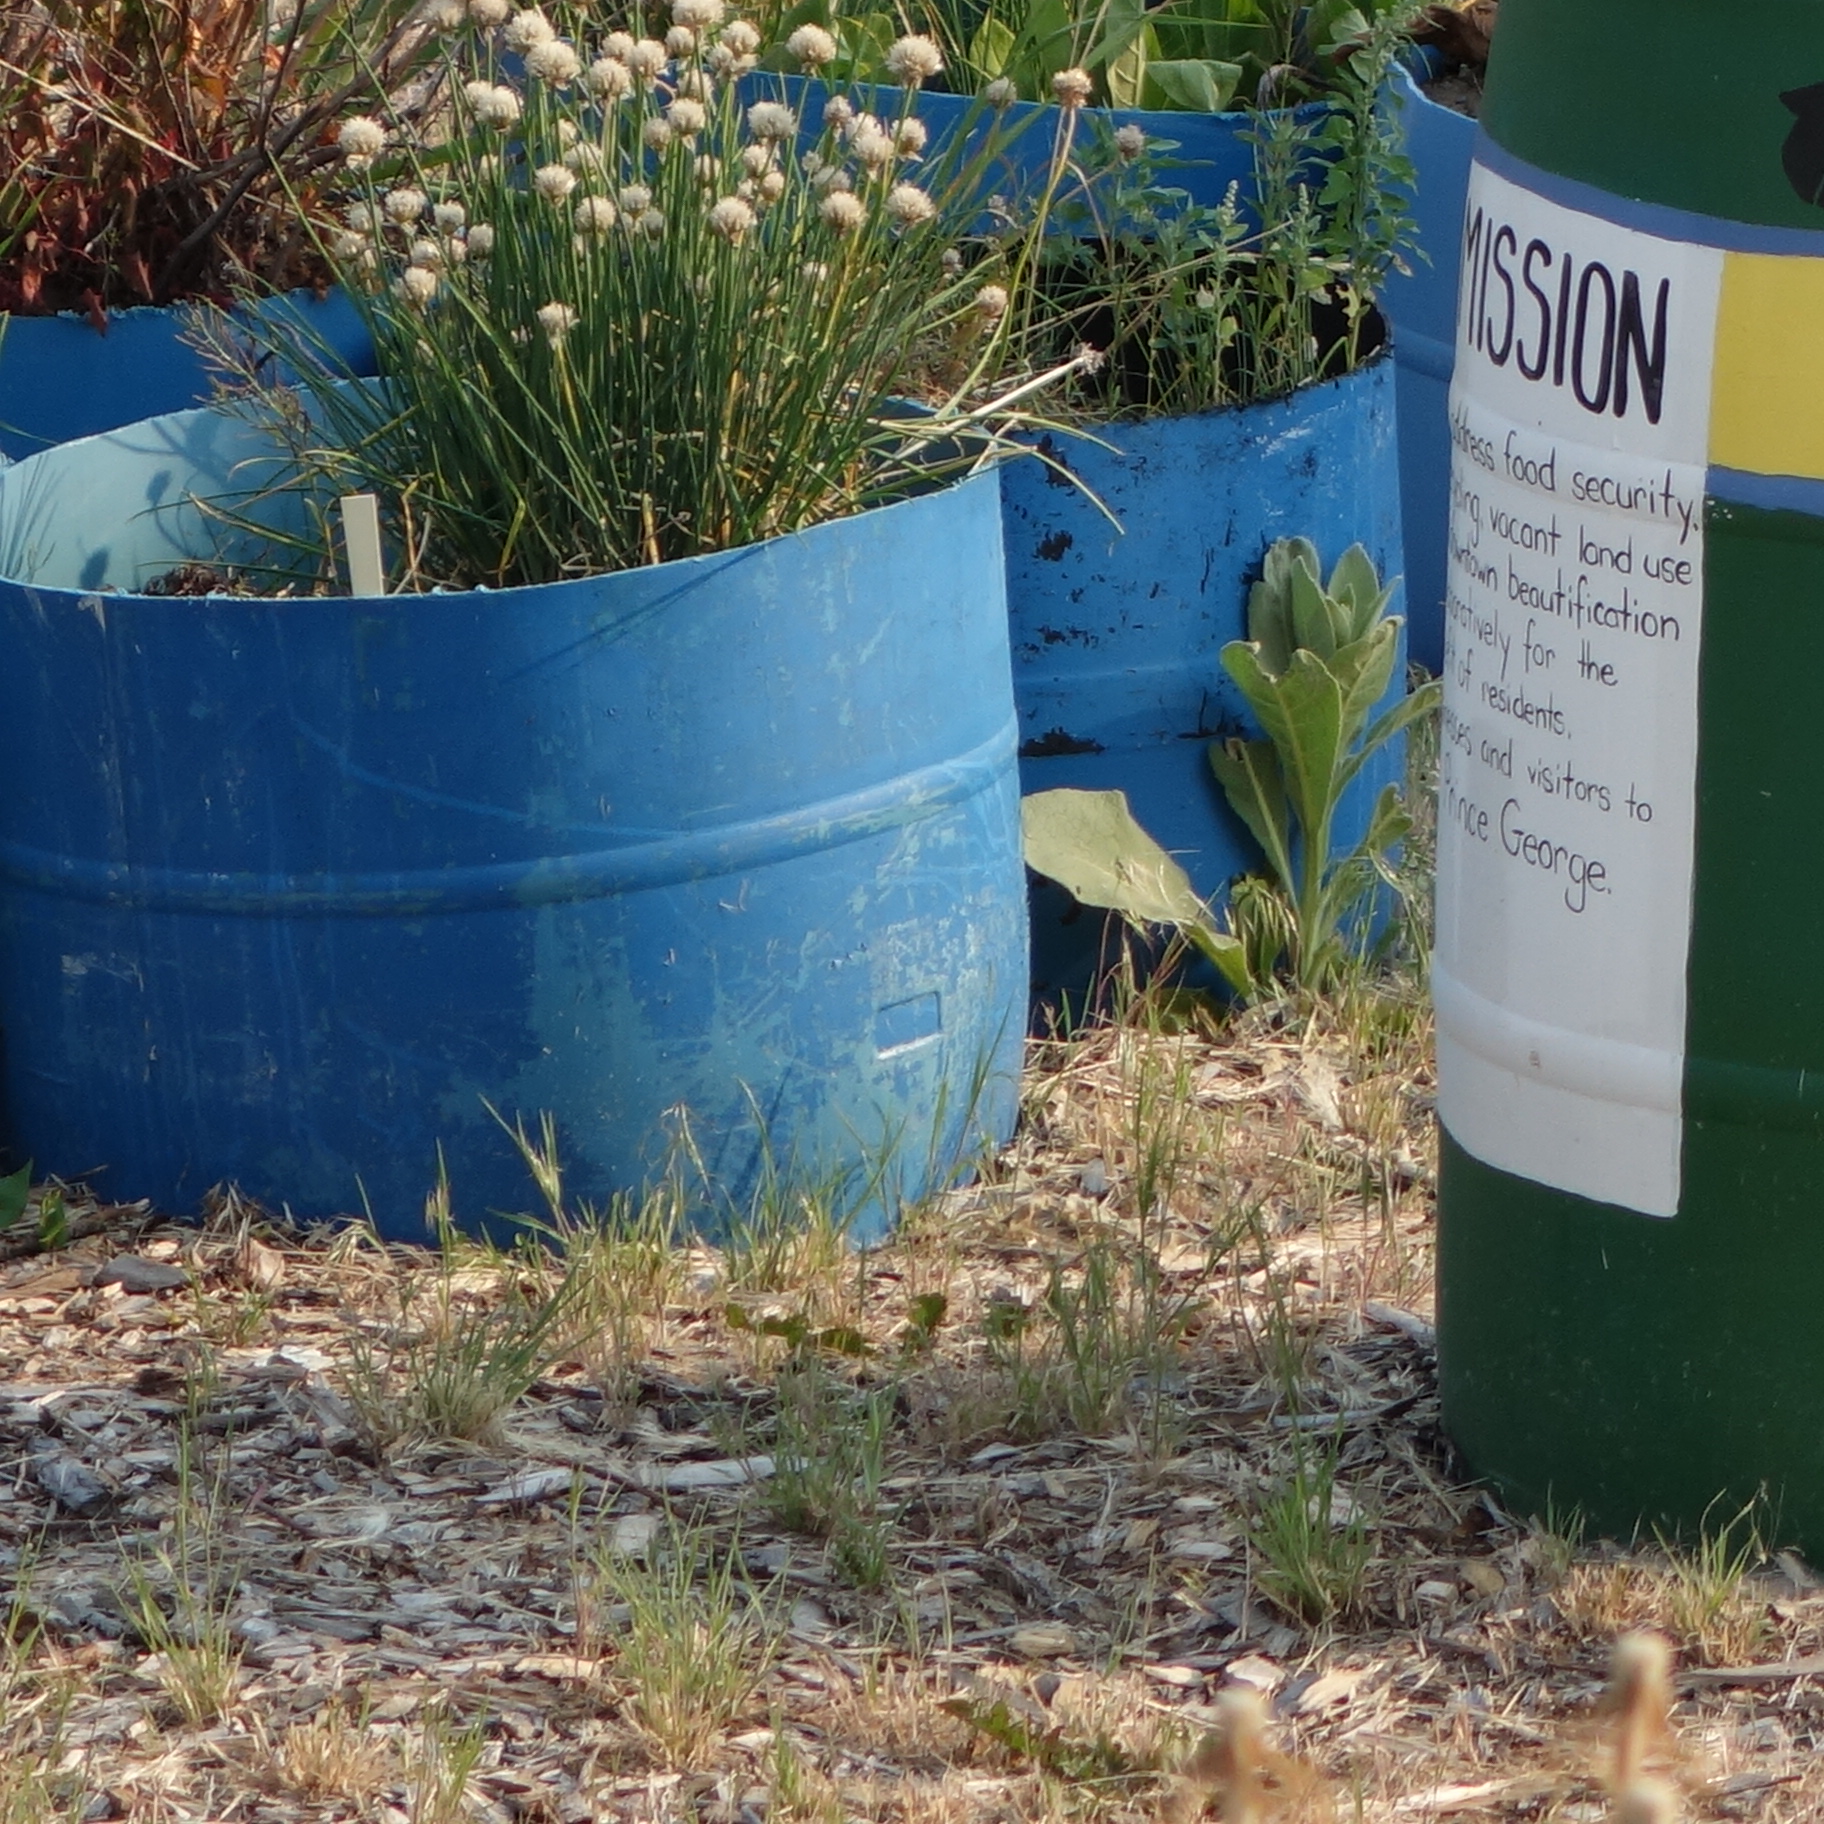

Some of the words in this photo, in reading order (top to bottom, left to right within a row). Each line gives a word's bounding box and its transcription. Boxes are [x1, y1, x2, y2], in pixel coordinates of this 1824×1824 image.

[1464, 196, 1670, 425] MISSION
[1504, 430, 1556, 492] food
[1489, 506, 1562, 557] vacant
[1579, 524, 1632, 575] land
[1643, 554, 1693, 586] use
[1508, 552, 1680, 642] beautification
[1523, 618, 1556, 674] for
[1577, 638, 1618, 687] the
[1481, 738, 1513, 779] and
[1527, 758, 1611, 812] visitors
[1625, 782, 1653, 823] to
